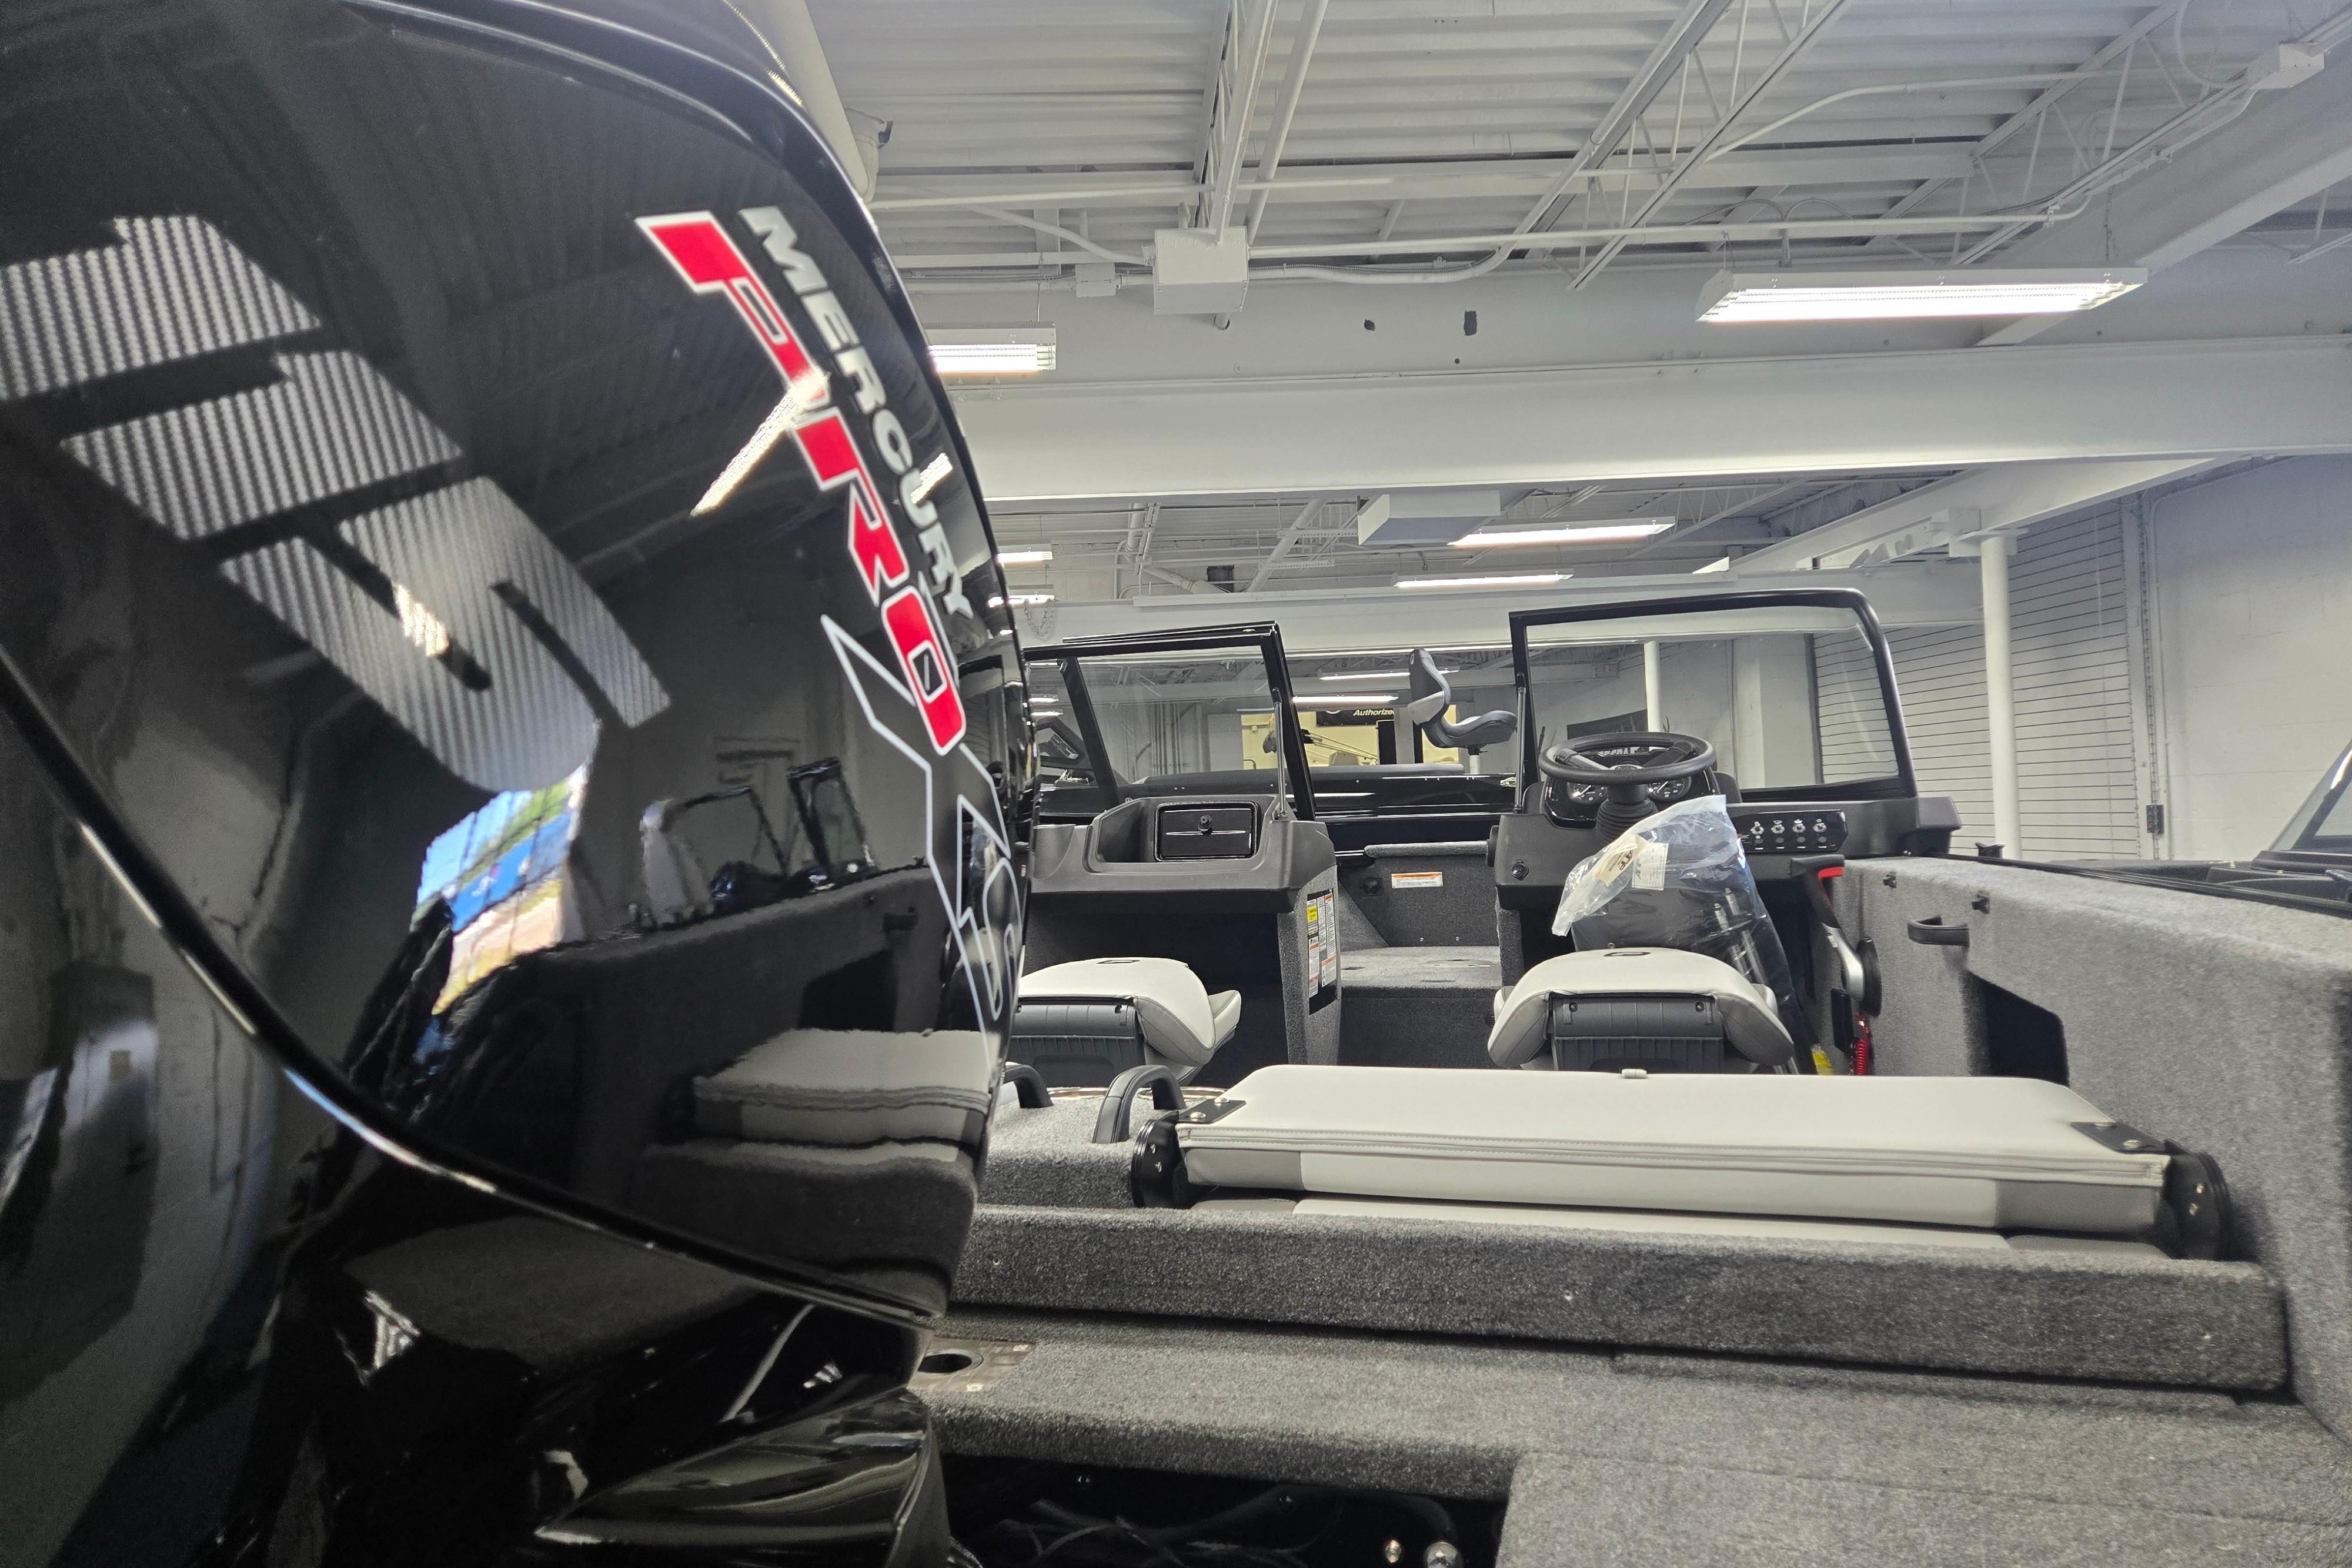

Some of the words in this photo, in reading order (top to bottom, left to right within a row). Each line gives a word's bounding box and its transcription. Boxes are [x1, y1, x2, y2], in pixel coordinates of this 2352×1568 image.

[0, 215, 670, 791] 115
[635, 210, 967, 756] PRO
[739, 206, 974, 619] MERCURY
[1352, 708, 1394, 717] Authorize
